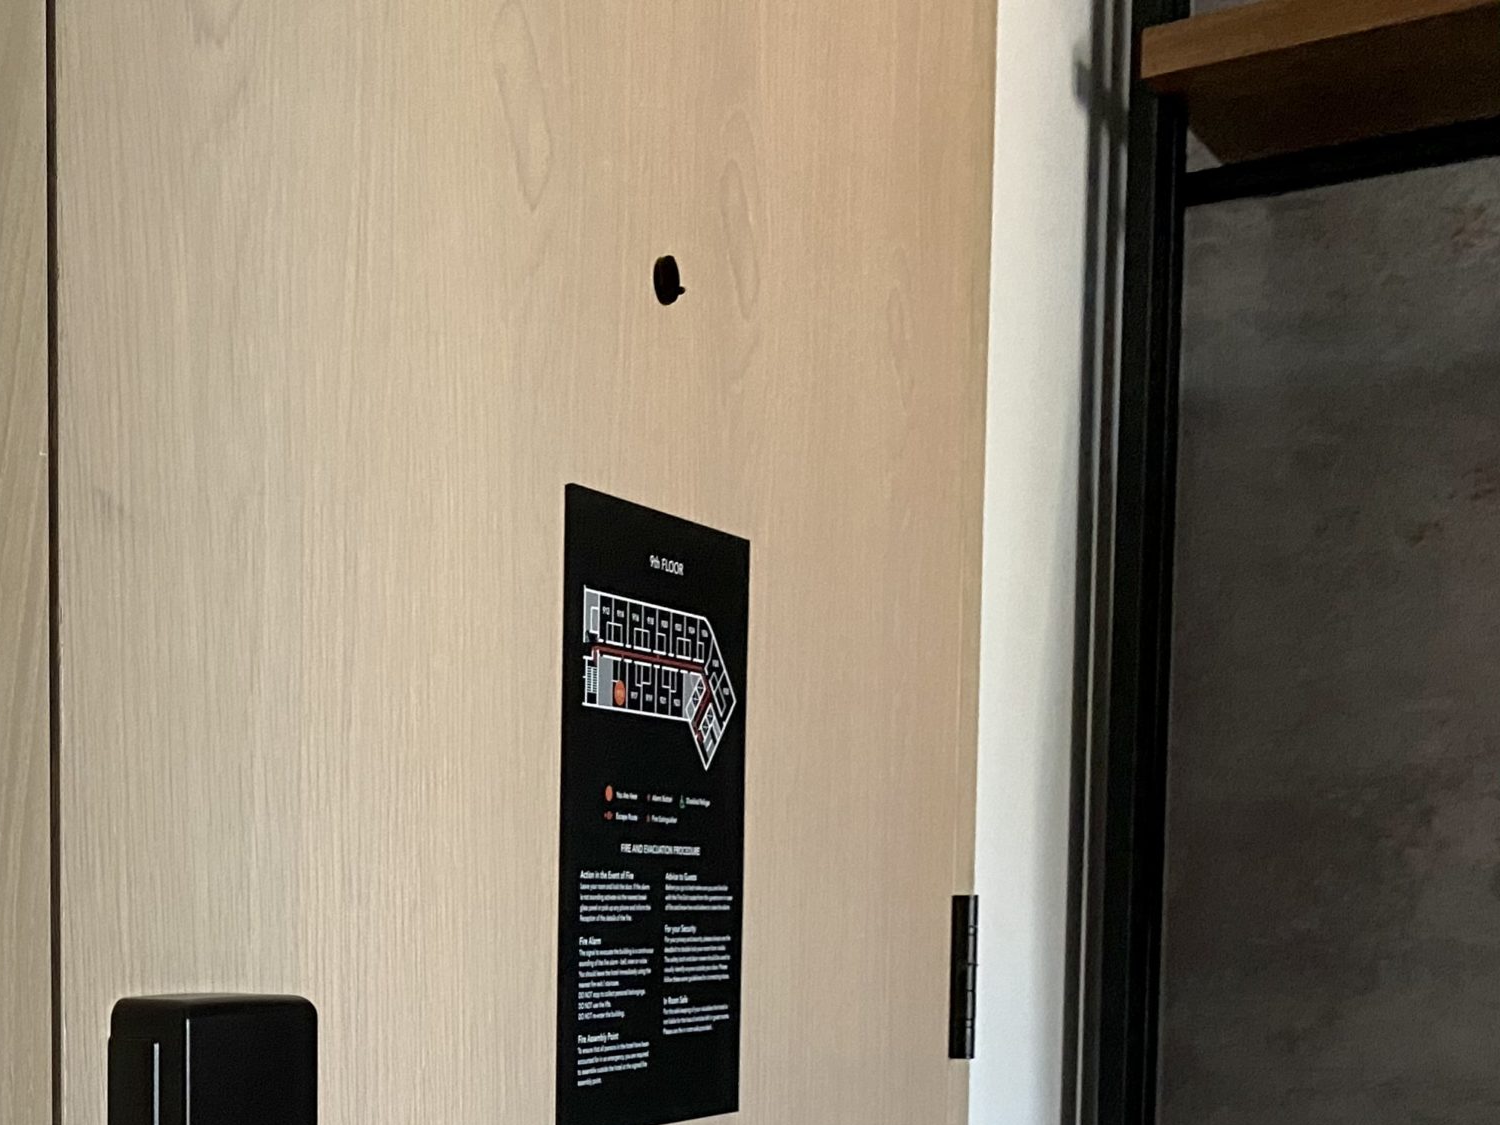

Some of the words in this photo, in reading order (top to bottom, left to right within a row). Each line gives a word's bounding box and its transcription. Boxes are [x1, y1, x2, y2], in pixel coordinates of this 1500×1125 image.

[649, 555, 660, 569] 9th
[661, 558, 684, 576] FLOOR
[620, 843, 631, 853] FIRE
[632, 844, 643, 854] AND
[643, 844, 673, 855] EVACUATION
[673, 846, 701, 856] PROCEDURE
